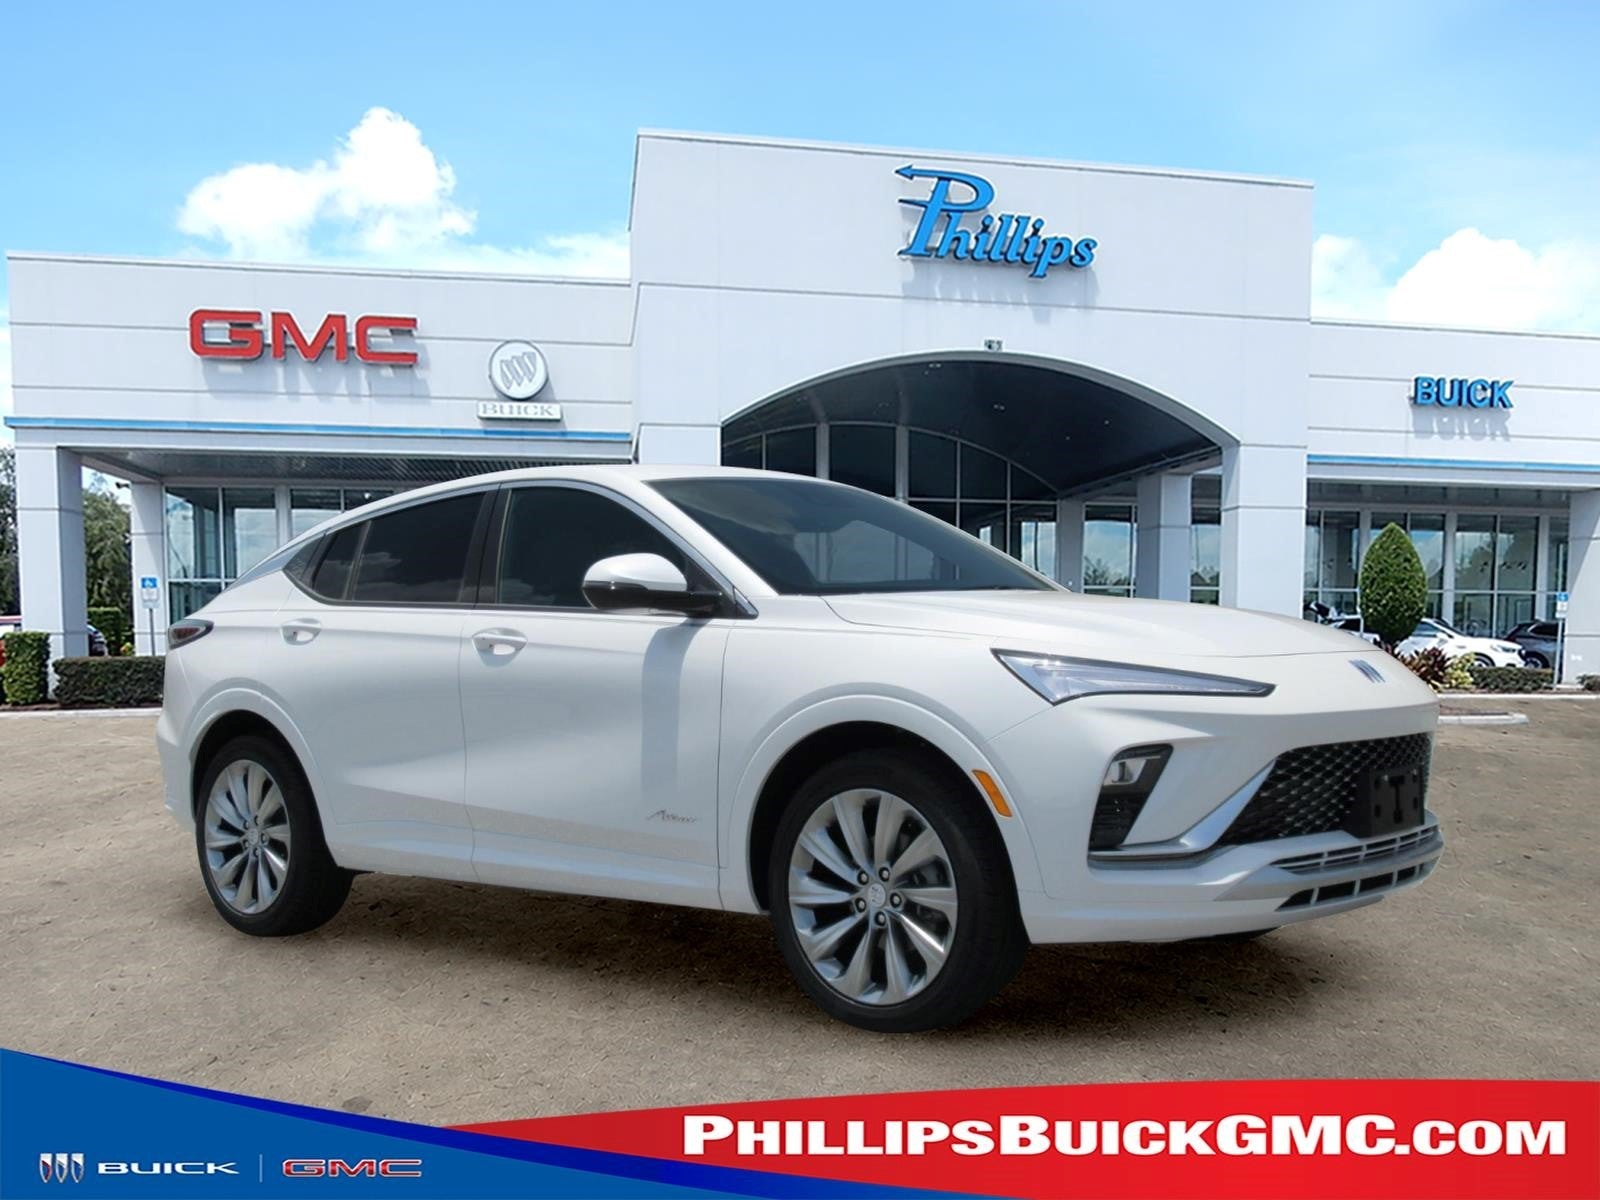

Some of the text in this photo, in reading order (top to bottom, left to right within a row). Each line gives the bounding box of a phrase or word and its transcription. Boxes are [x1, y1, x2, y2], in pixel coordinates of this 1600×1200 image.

[894, 165, 1098, 278] Phillips
[189, 308, 418, 364] GMC
[482, 403, 554, 417] BUICK
[1414, 376, 1514, 408] BUICK
